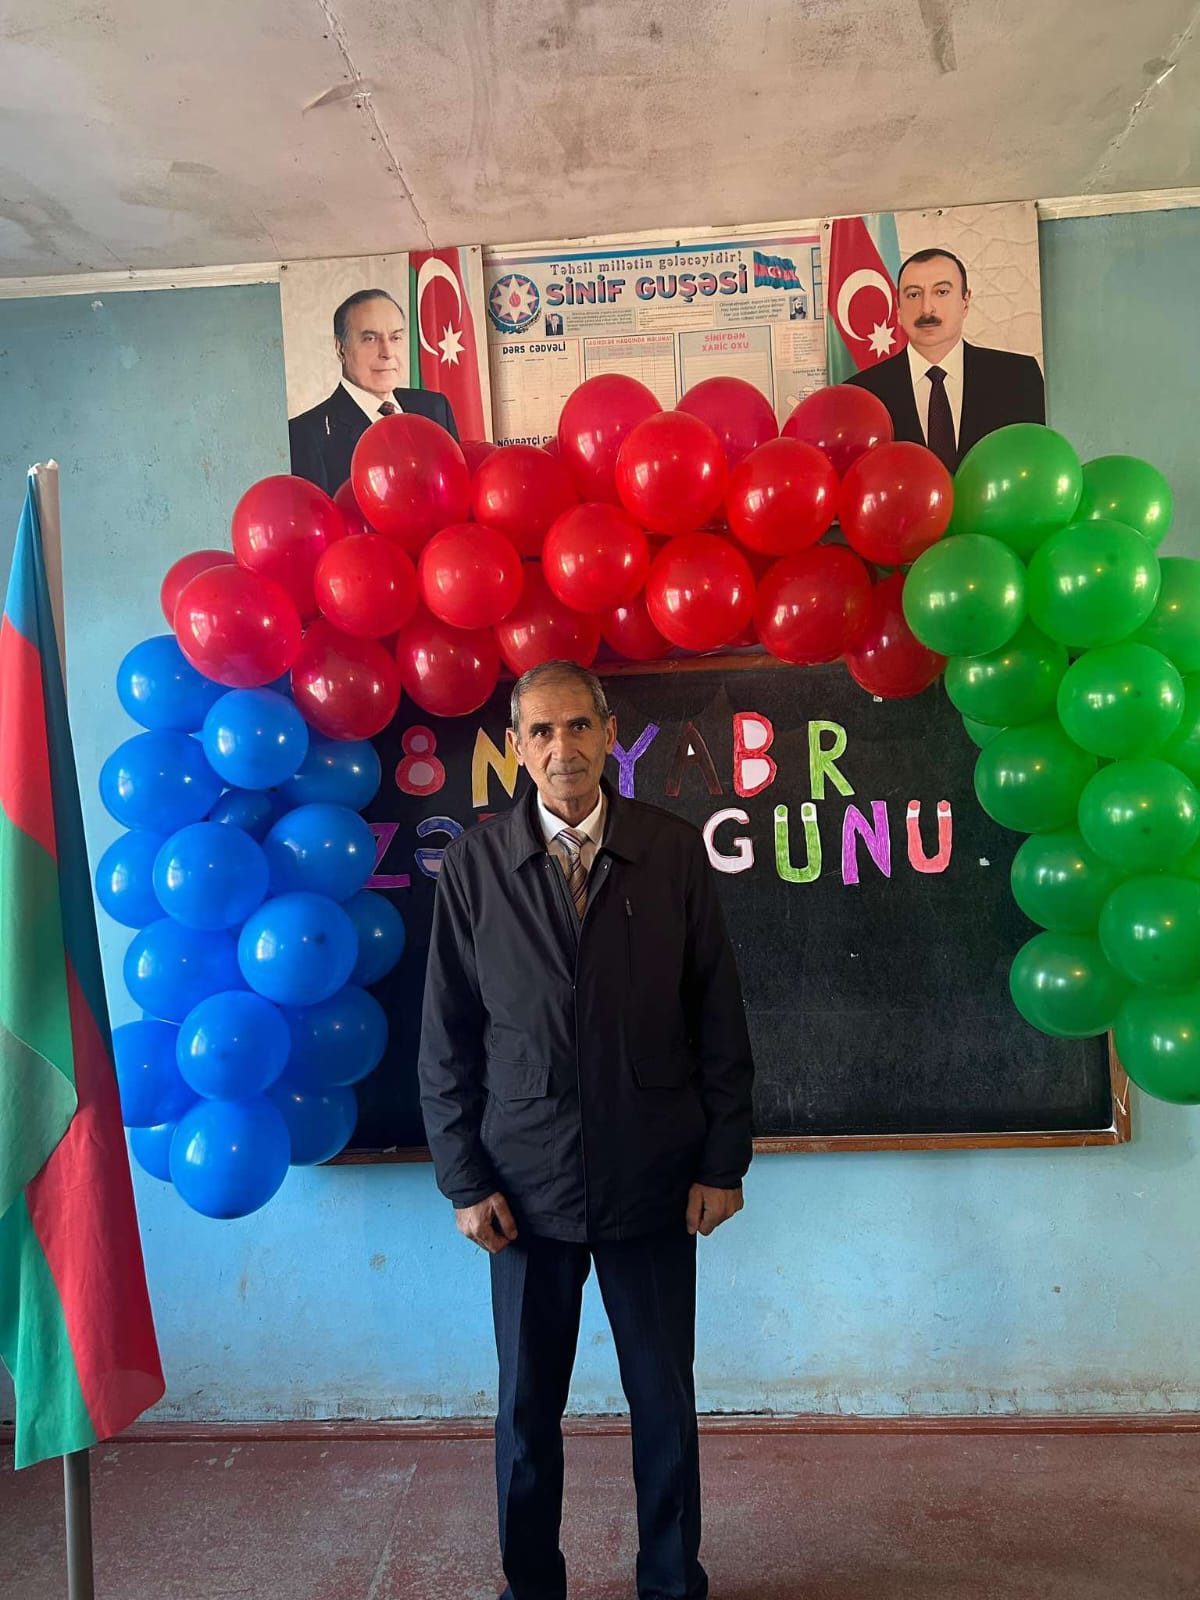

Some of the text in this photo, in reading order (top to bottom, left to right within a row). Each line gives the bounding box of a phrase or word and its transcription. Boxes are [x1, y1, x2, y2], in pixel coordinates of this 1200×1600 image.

[550, 251, 743, 275] Təhsil millətin gələcəyidir!
[546, 274, 626, 306] SİNİF
[502, 340, 566, 355] DƏRS CƏDVƏLİ
[730, 341, 749, 351] OXU
[395, 711, 855, 808] 8 NYABR
